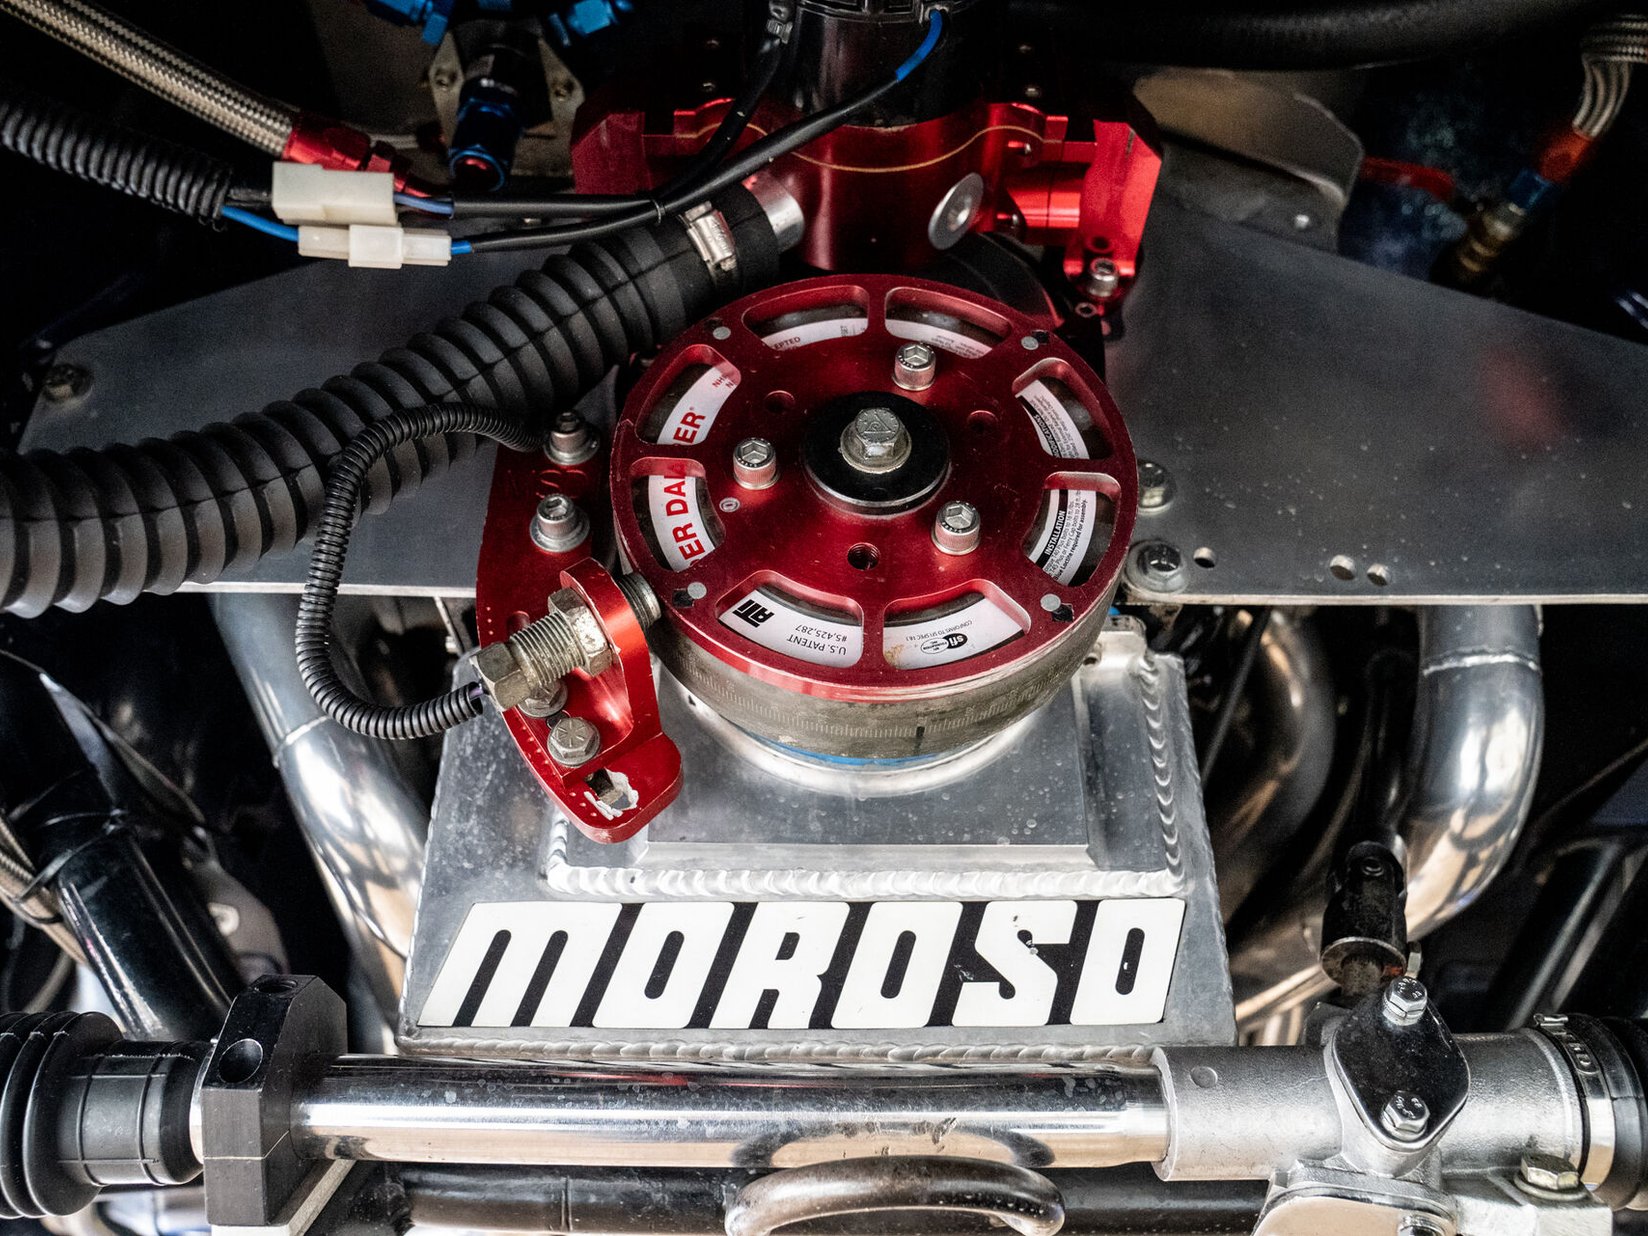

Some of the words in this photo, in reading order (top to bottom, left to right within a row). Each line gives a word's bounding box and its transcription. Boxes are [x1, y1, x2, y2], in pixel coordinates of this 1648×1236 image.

[1044, 510, 1066, 556] INSTALLATION
[1072, 530, 1082, 551] required
[787, 633, 826, 652] PATENT
[795, 624, 848, 642] #5,425,287
[949, 635, 964, 647] sfi
[416, 898, 1186, 1029] MOROSO
